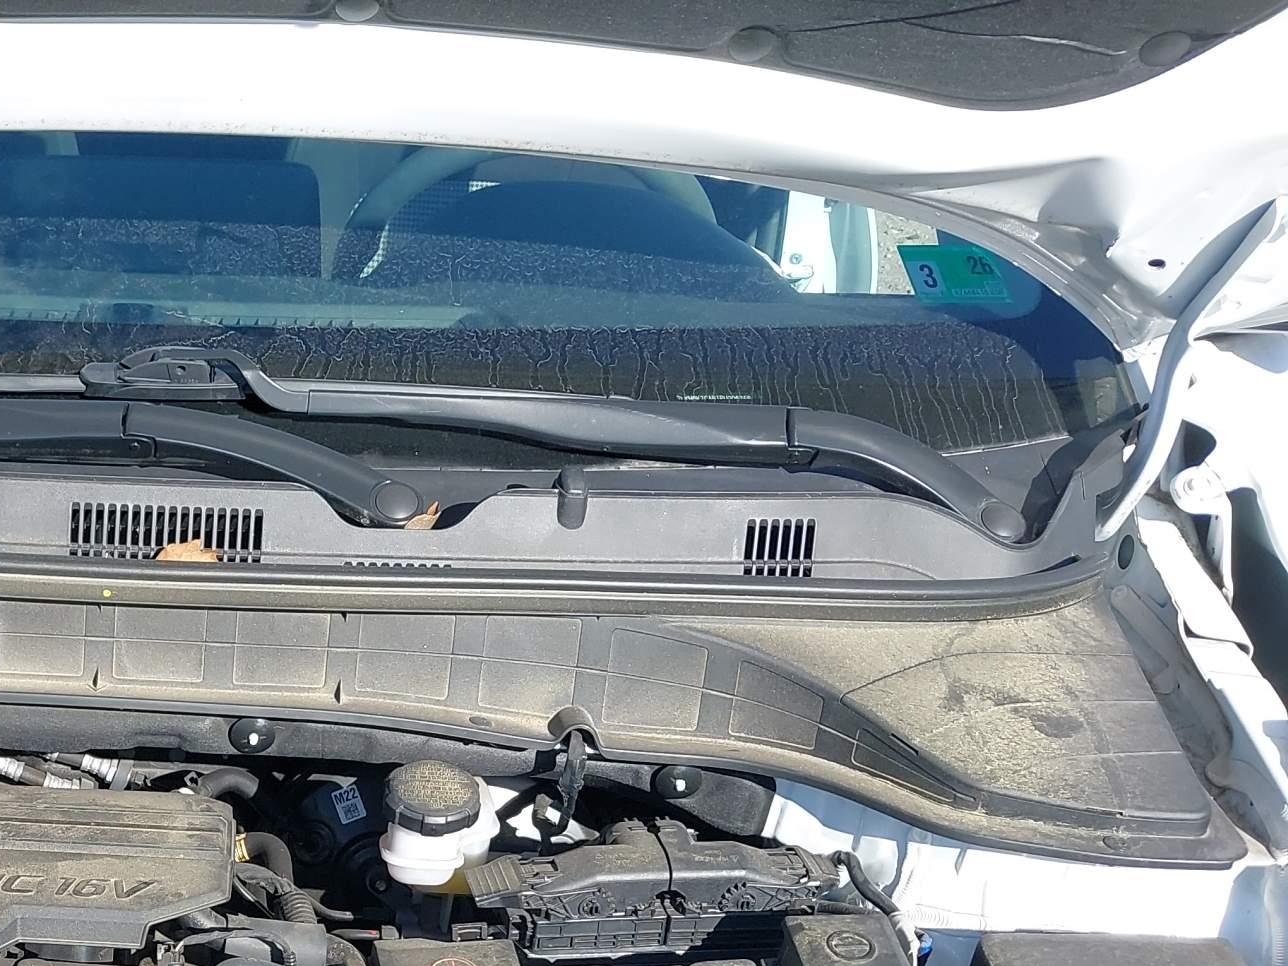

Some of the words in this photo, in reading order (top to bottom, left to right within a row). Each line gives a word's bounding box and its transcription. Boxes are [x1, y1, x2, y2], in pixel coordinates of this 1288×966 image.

[966, 255, 995, 275] 26
[919, 264, 938, 289] 3
[333, 788, 359, 805] M22
[54, 876, 158, 900] 16V
